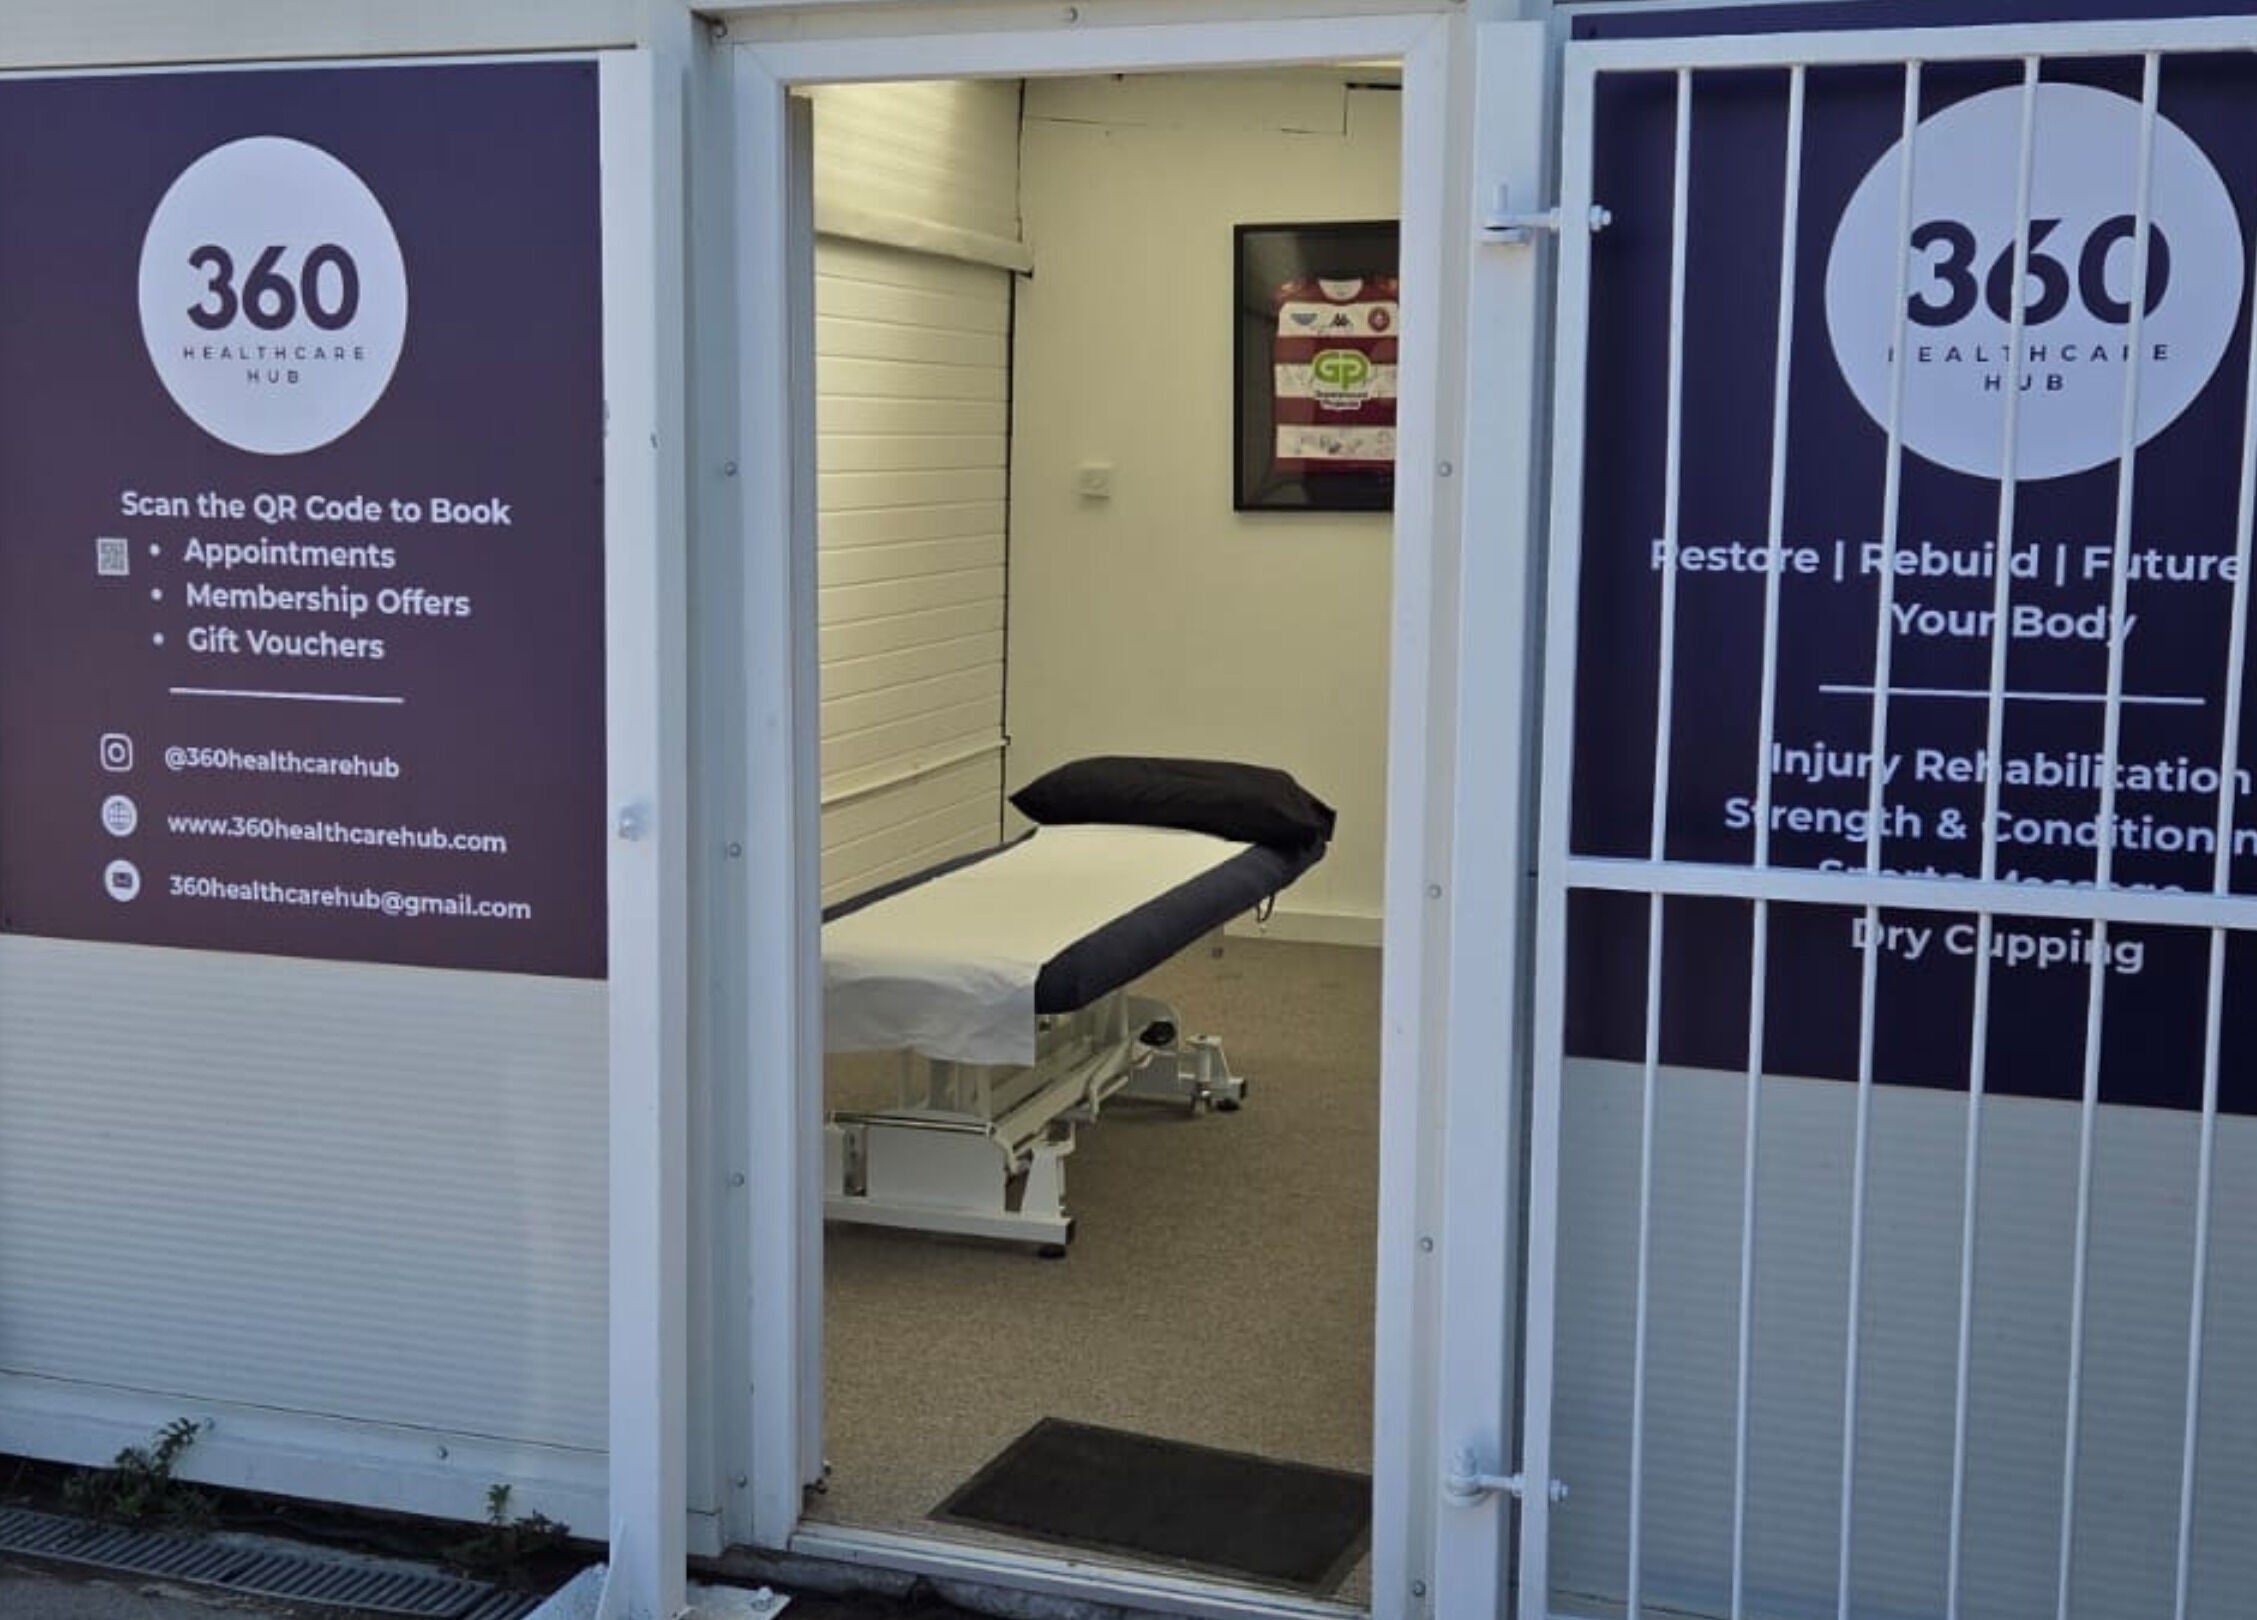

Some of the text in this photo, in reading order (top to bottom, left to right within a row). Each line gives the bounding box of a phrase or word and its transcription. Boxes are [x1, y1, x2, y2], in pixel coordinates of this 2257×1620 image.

[187, 243, 359, 330] 360
[1905, 214, 2171, 327] 360
[183, 346, 364, 360] HEALTHCARE
[247, 369, 298, 384] HUB
[122, 491, 512, 525] Scan the QR Code to Book
[184, 537, 396, 569] Appointments
[1651, 539, 1820, 573] Restore
[1860, 541, 2039, 578] Rebuid
[187, 583, 471, 618] Membership Offers
[1890, 603, 1996, 637] Your
[188, 626, 384, 659] Gift Vouchers
[165, 746, 400, 778] @360healthcarehub
[1771, 741, 1901, 785] Injury
[168, 816, 507, 852] www.360healthcarehub.com
[1725, 798, 1921, 842] Srength
[1937, 808, 1967, 839] &
[170, 875, 532, 919] 360healthcarehub@gmail.com
[1852, 918, 1932, 959] Dry
